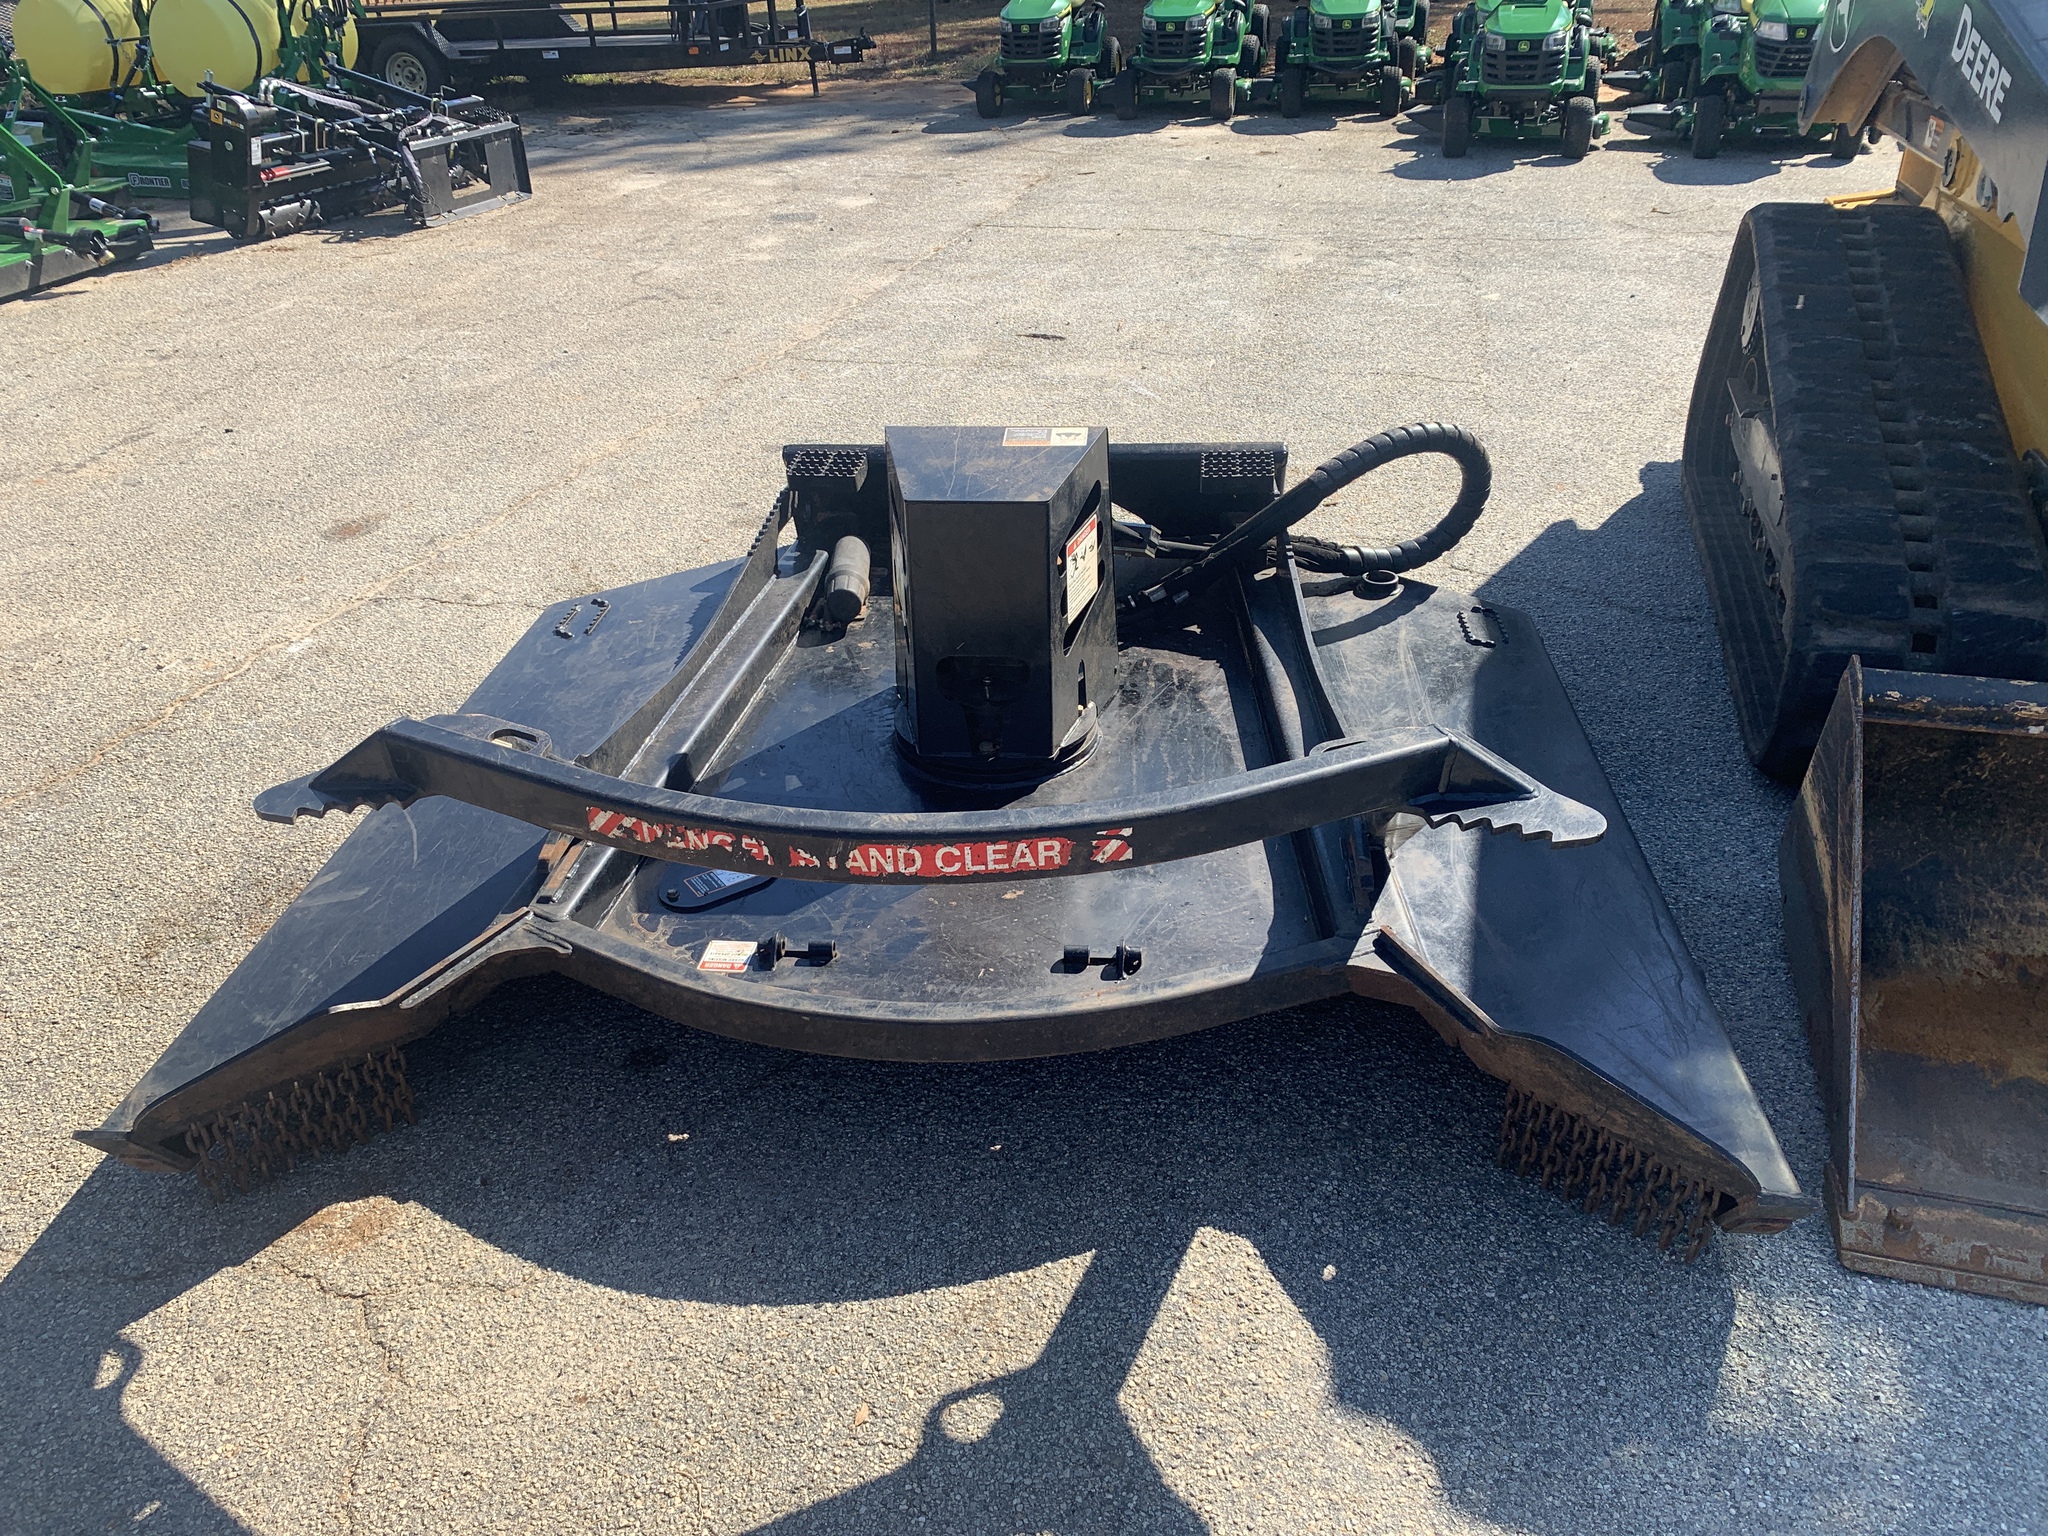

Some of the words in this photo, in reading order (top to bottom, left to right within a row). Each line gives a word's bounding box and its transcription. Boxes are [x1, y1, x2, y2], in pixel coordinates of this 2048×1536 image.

[769, 46, 813, 62] LINX
[1951, 3, 2013, 124] DEERE
[128, 173, 171, 188] FRONTIER
[795, 846, 922, 873] SAND
[935, 840, 1062, 872] CLEAR
